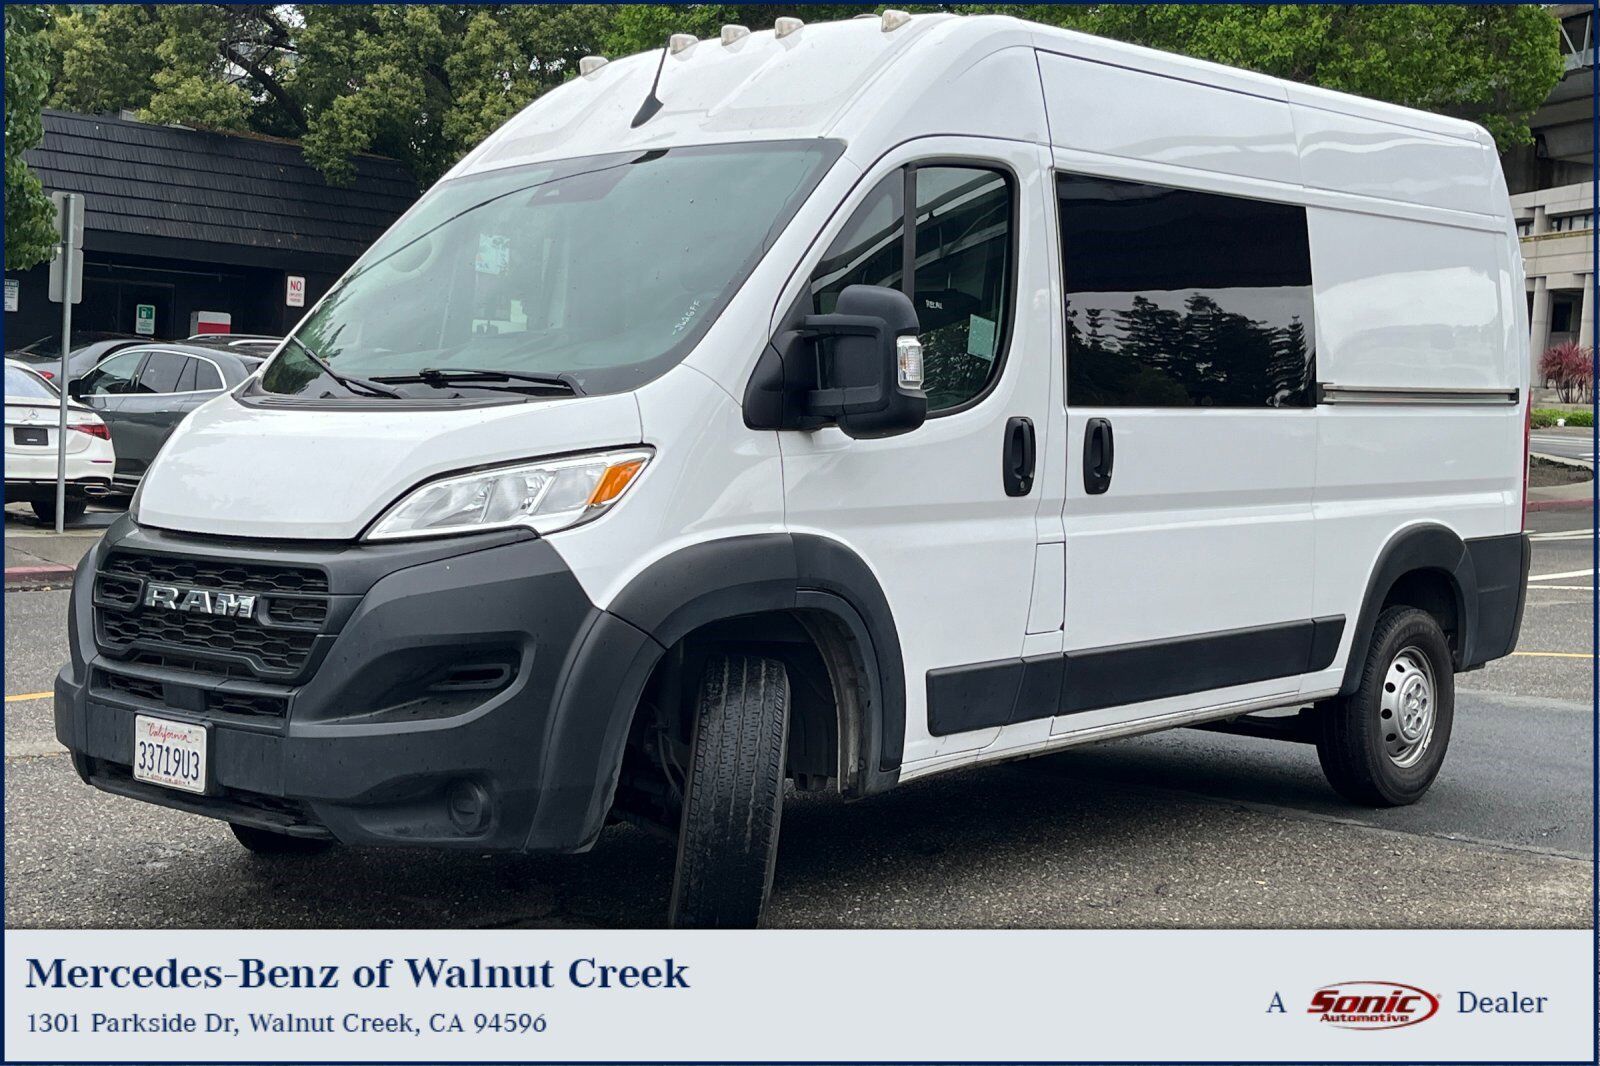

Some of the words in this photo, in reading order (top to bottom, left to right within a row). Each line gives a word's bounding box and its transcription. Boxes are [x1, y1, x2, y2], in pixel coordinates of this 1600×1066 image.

[290, 280, 302, 291] NO
[145, 582, 256, 619] RAM
[148, 722, 192, 743] California
[139, 741, 200, 781] 33719U3
